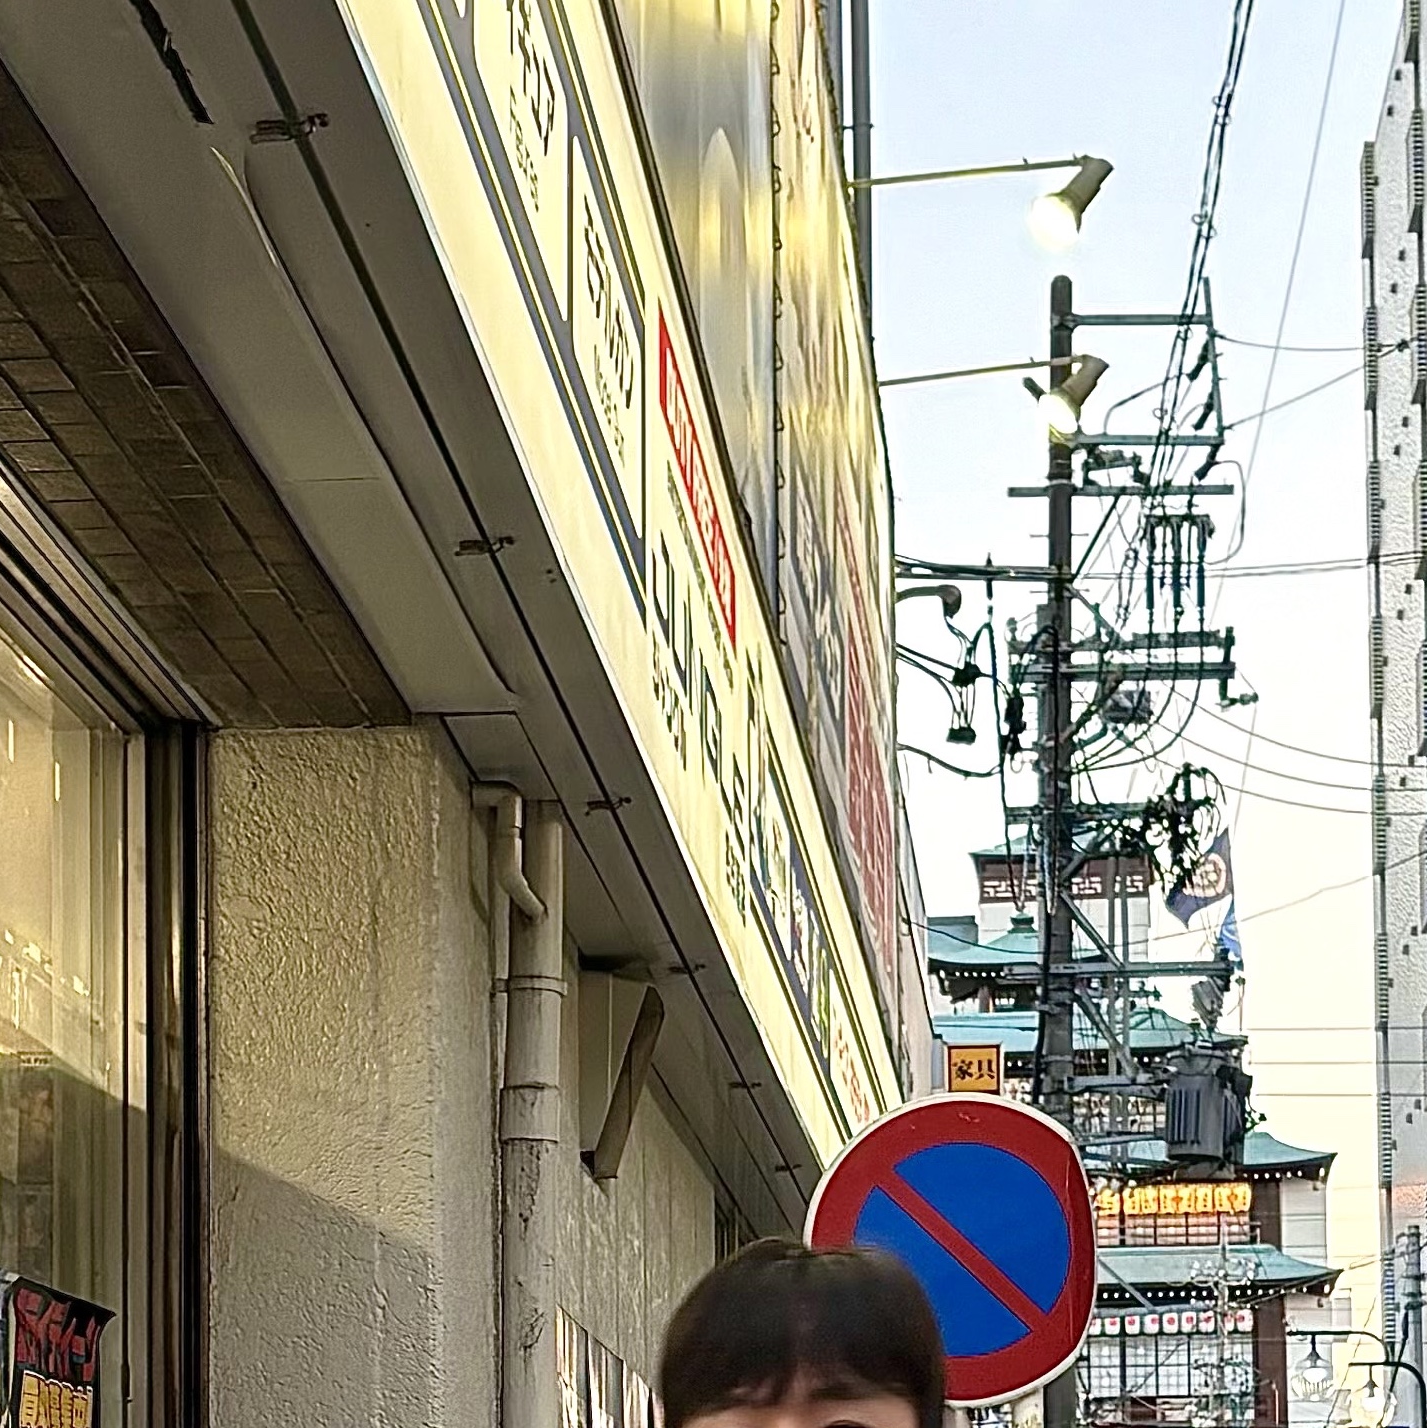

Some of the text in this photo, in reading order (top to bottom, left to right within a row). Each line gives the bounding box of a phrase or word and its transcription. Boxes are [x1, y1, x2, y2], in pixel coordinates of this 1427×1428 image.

[582, 194, 633, 410] モデルガン
[952, 1058, 995, 1080] 家具
